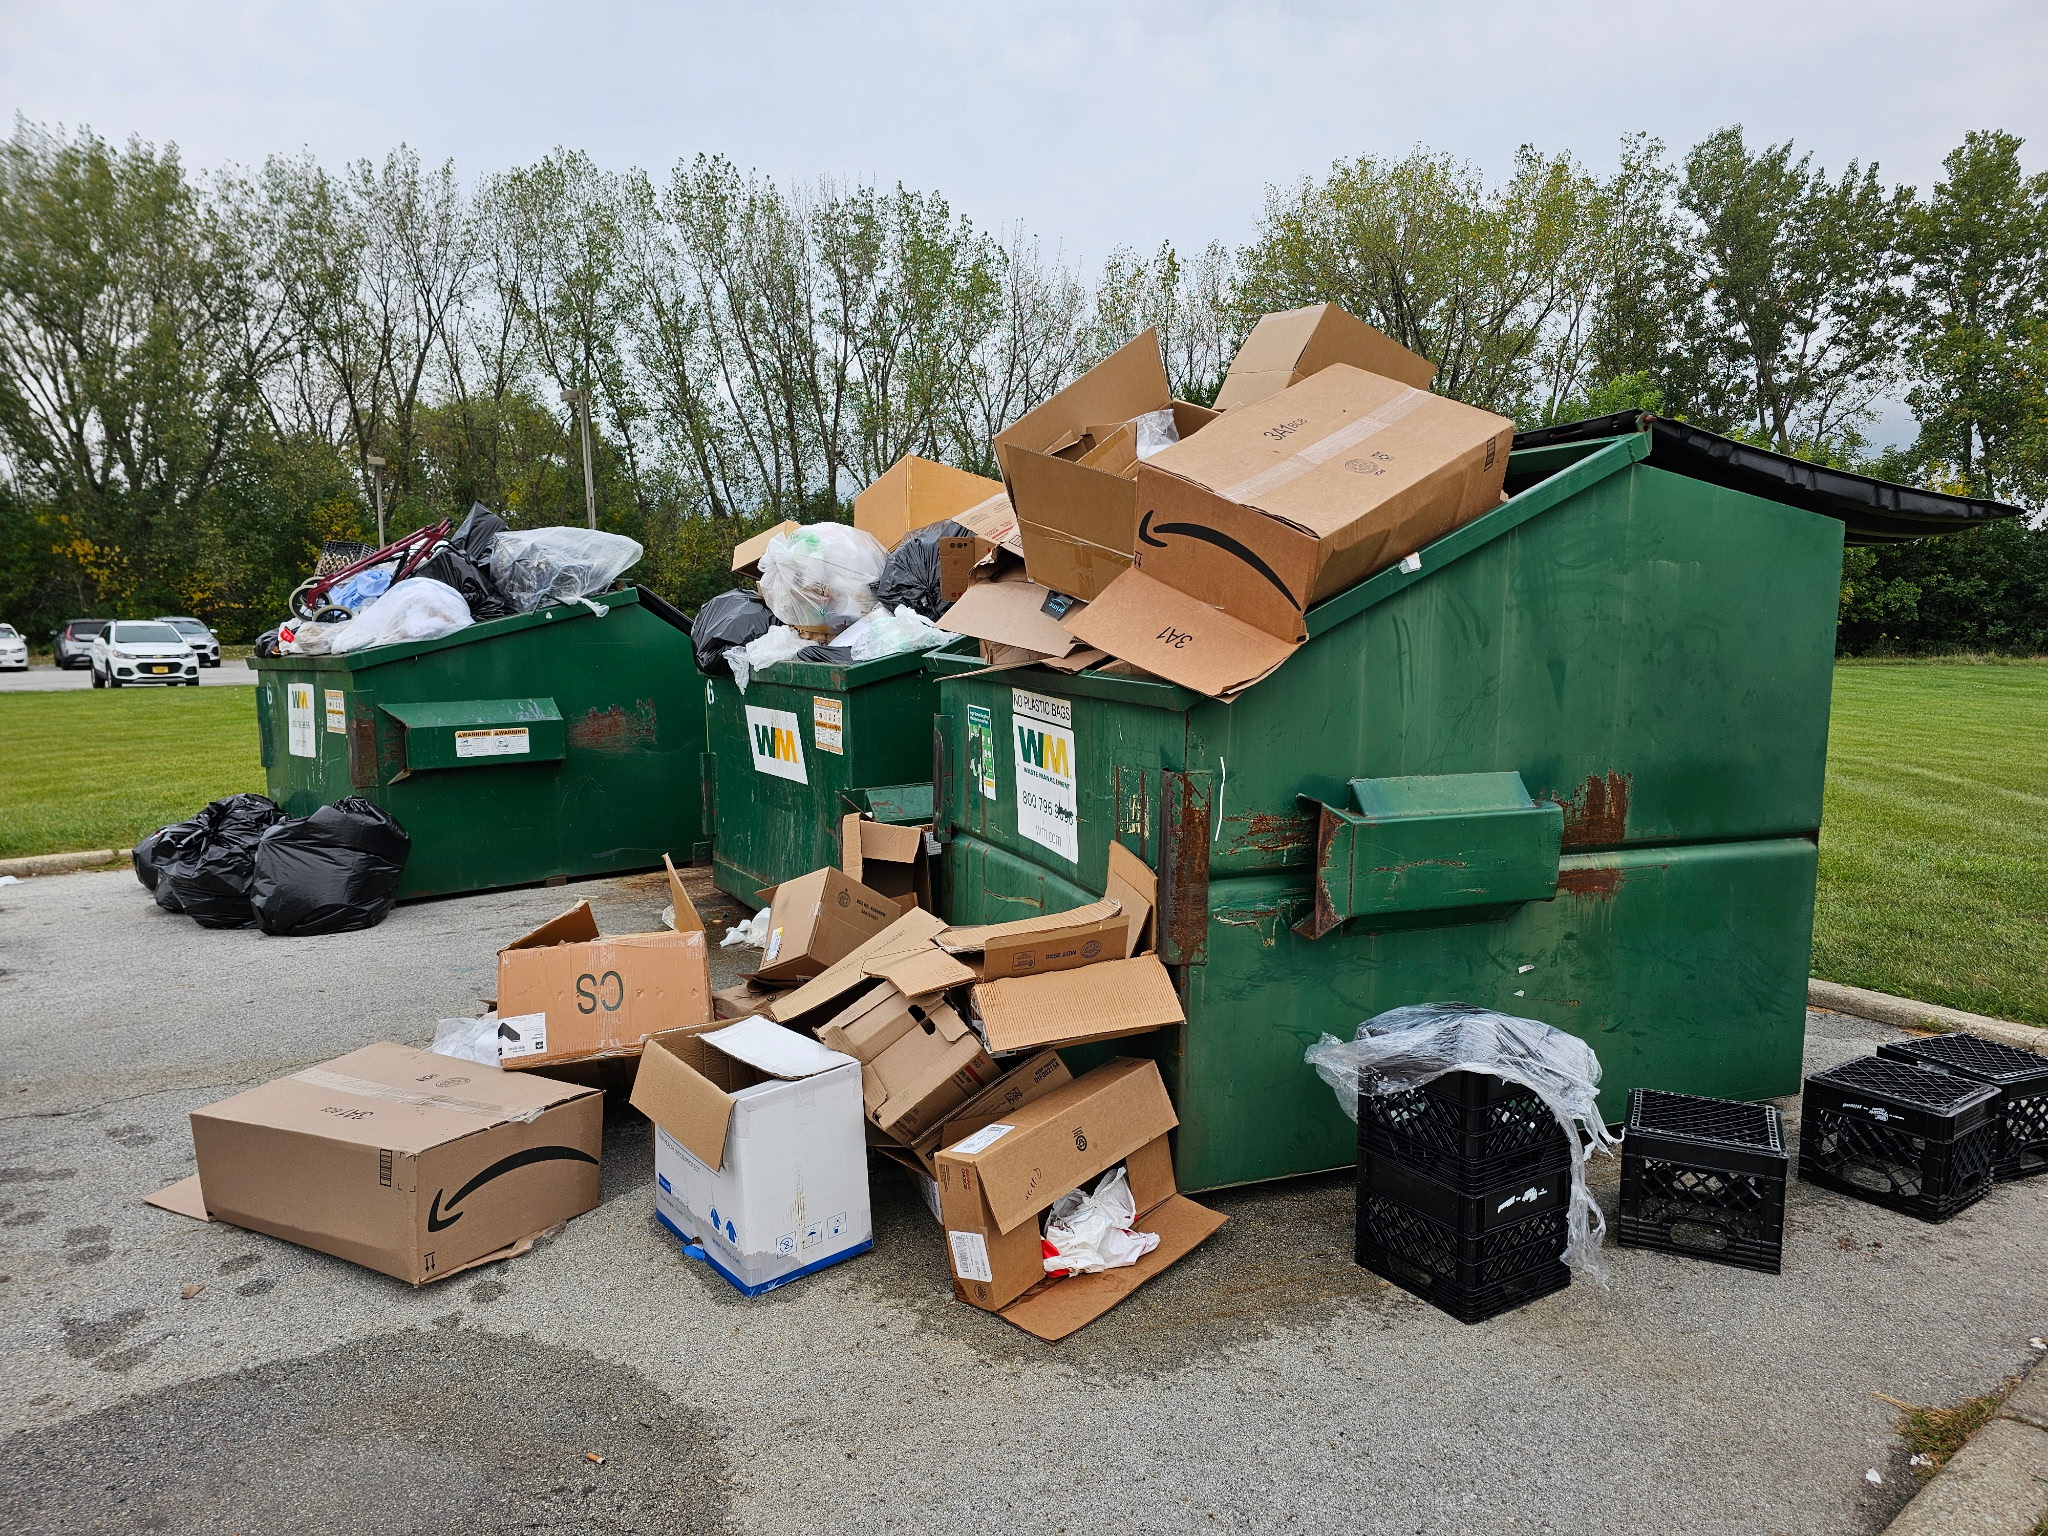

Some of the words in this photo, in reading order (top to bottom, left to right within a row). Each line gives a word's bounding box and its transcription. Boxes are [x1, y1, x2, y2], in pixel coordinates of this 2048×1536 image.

[1048, 602, 1067, 613] prime
[1156, 626, 1193, 649] 3A1
[266, 682, 273, 705] 6
[292, 691, 309, 709] WM
[706, 678, 715, 705] 6
[1013, 693, 1023, 708] NO
[1023, 697, 1050, 716] PLASTIC
[1051, 703, 1071, 721] BAGS
[754, 723, 799, 764] WM
[1018, 725, 1070, 779] WM
[1023, 767, 1039, 778] WASTE
[1022, 790, 1037, 809] 800
[1038, 796, 1053, 816] 796
[1035, 824, 1062, 848] wm.com
[576, 970, 624, 1015] CS
